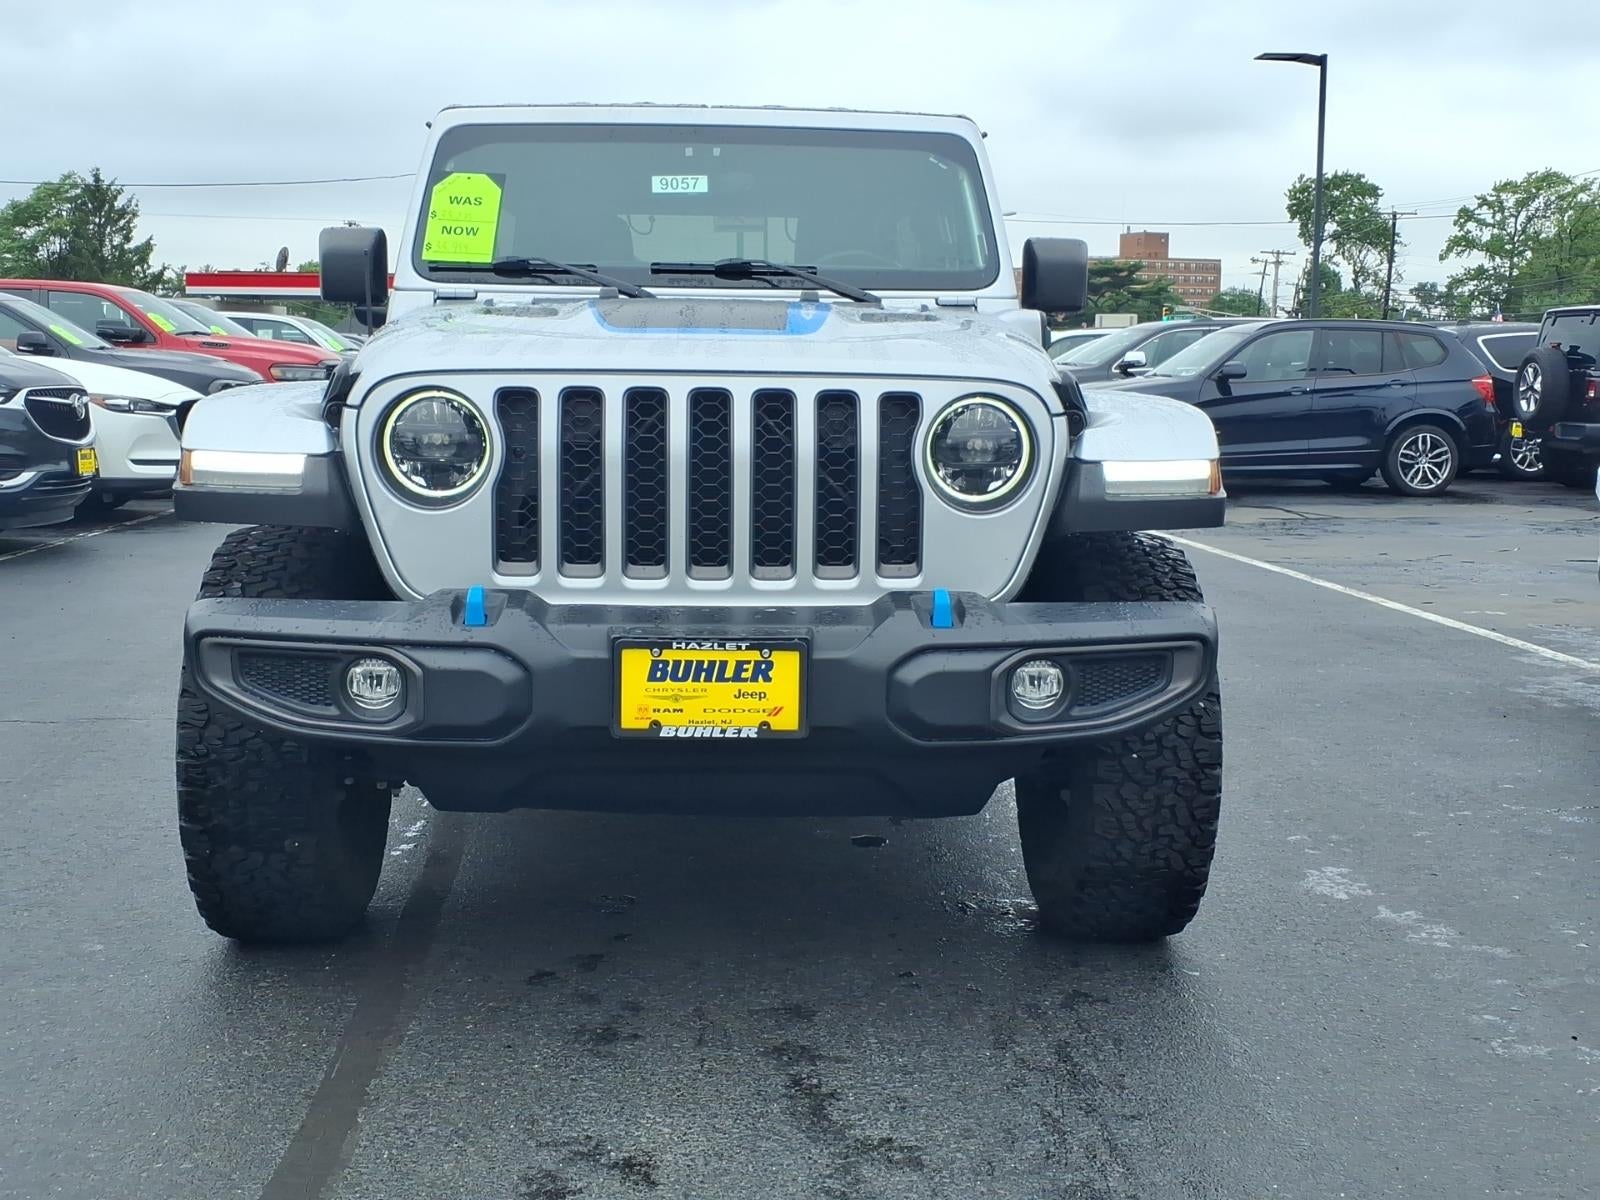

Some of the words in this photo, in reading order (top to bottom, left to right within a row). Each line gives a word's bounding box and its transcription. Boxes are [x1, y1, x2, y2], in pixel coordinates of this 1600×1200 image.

[659, 176, 700, 191] 9057
[448, 195, 483, 206] WAS
[441, 225, 480, 237] NOW
[672, 642, 750, 650] HAZLET
[647, 659, 774, 683] BUHLER
[733, 688, 767, 701] Jeep
[660, 726, 758, 737] BUHLER
